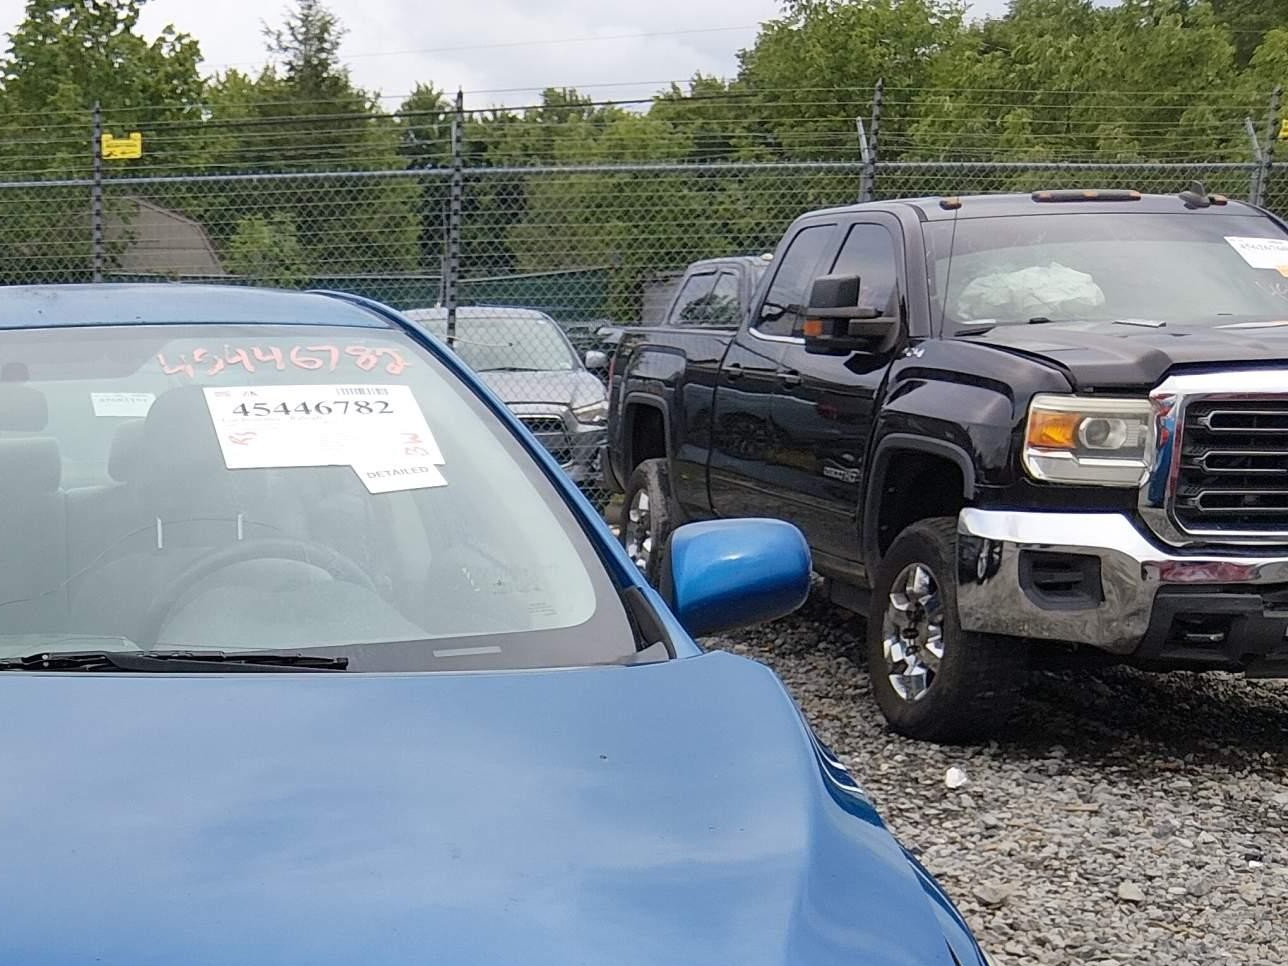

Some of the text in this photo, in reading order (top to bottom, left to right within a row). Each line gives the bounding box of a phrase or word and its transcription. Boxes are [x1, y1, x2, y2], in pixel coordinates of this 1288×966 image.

[157, 344, 412, 378] 45446782
[232, 400, 394, 417] 45446782
[366, 465, 430, 480] DETAILED
